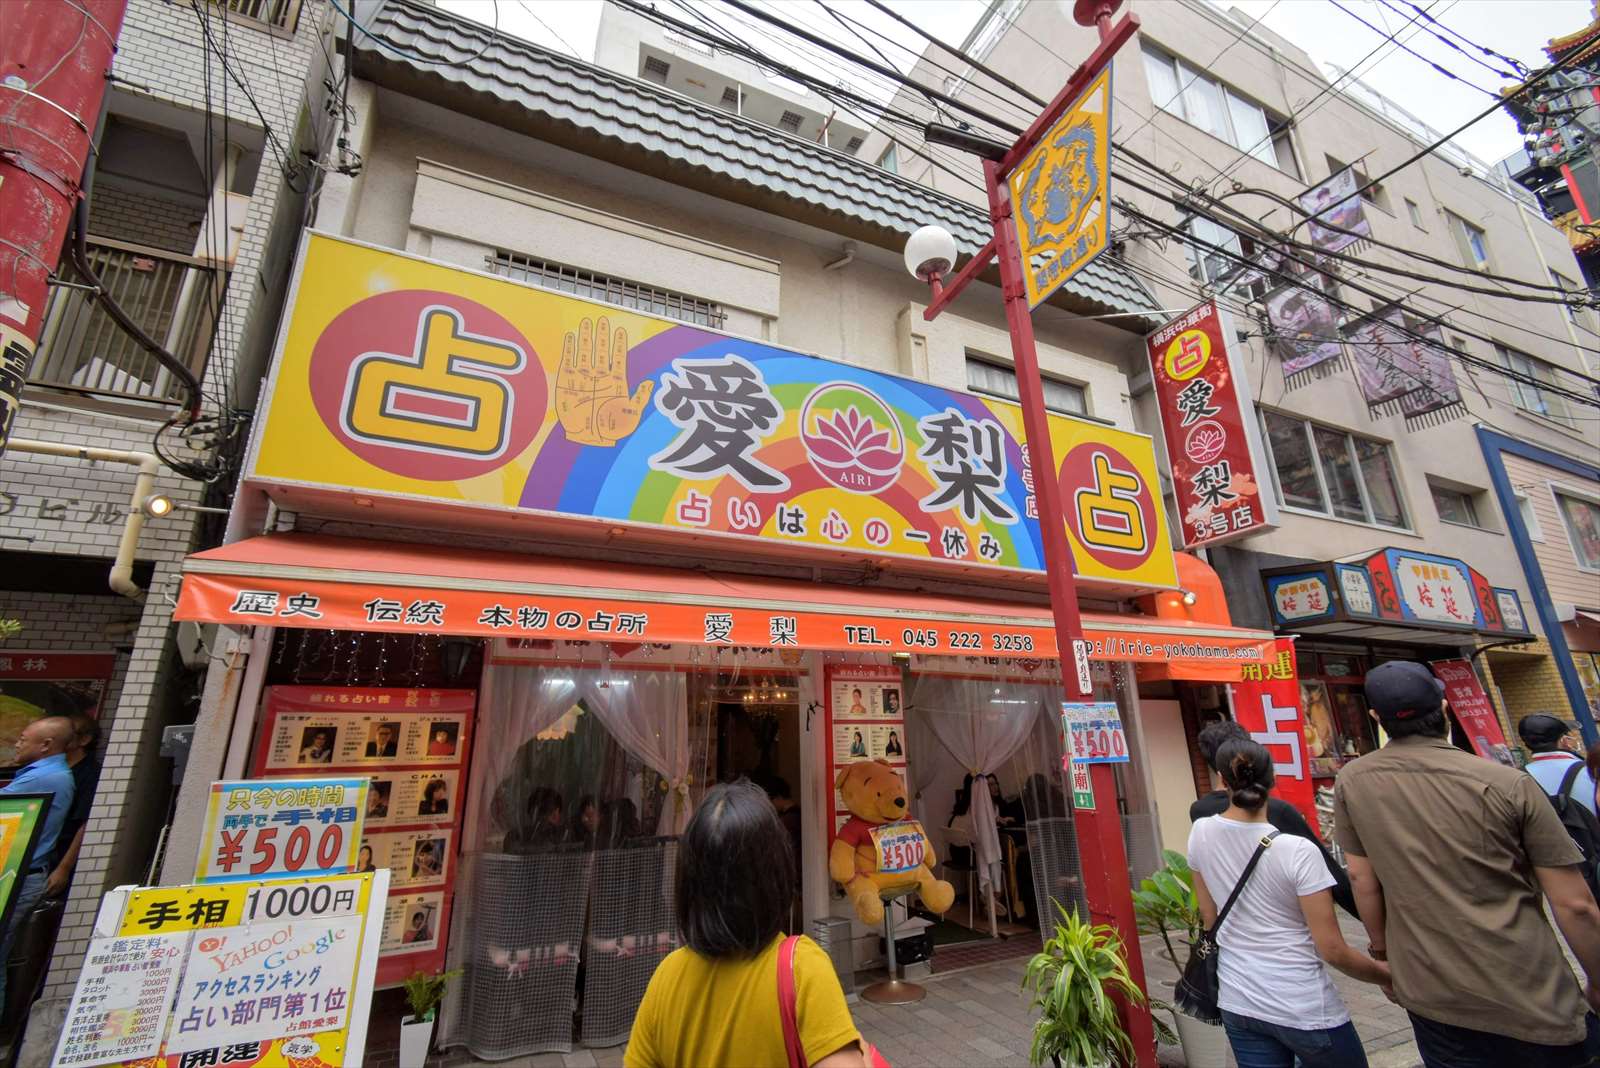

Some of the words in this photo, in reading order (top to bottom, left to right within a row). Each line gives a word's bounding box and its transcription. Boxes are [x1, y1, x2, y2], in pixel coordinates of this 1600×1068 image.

[1152, 304, 1213, 347] 横浜中華街
[1173, 333, 1204, 375] 占
[339, 304, 527, 460] 占
[1177, 378, 1221, 426] 愛
[651, 355, 790, 492] 愛
[917, 408, 1018, 525] 梨
[839, 472, 872, 487] AIRI
[1192, 459, 1239, 508] 梨
[680, 492, 1000, 559] 占いは心の一休み
[1074, 451, 1148, 555] 占
[1195, 505, 1253, 538] 3号店
[230, 589, 324, 619] 歴史
[363, 599, 445, 627] 伝統
[478, 605, 649, 634] 本物の占所
[704, 613, 733, 644] 愛
[769, 617, 797, 645] 梨
[844, 626, 890, 645] TEL.
[902, 629, 937, 648] 045
[949, 632, 981, 650] 222
[992, 634, 1034, 651] 3258
[1072, 730, 1124, 758] ¥500
[1249, 694, 1303, 780] 占
[226, 784, 345, 810] 只今の時間
[216, 824, 343, 874] ¥500
[883, 842, 924, 869] ¥500
[138, 898, 229, 930] 手相
[248, 885, 354, 920] 1000円
[111, 937, 161, 952] 鑑定料
[150, 947, 180, 960] 安心
[209, 925, 293, 974] YAHOO!
[264, 928, 346, 969] Google
[192, 965, 322, 1000] アクセスランキング
[179, 987, 347, 1034] 占い部門第1位
